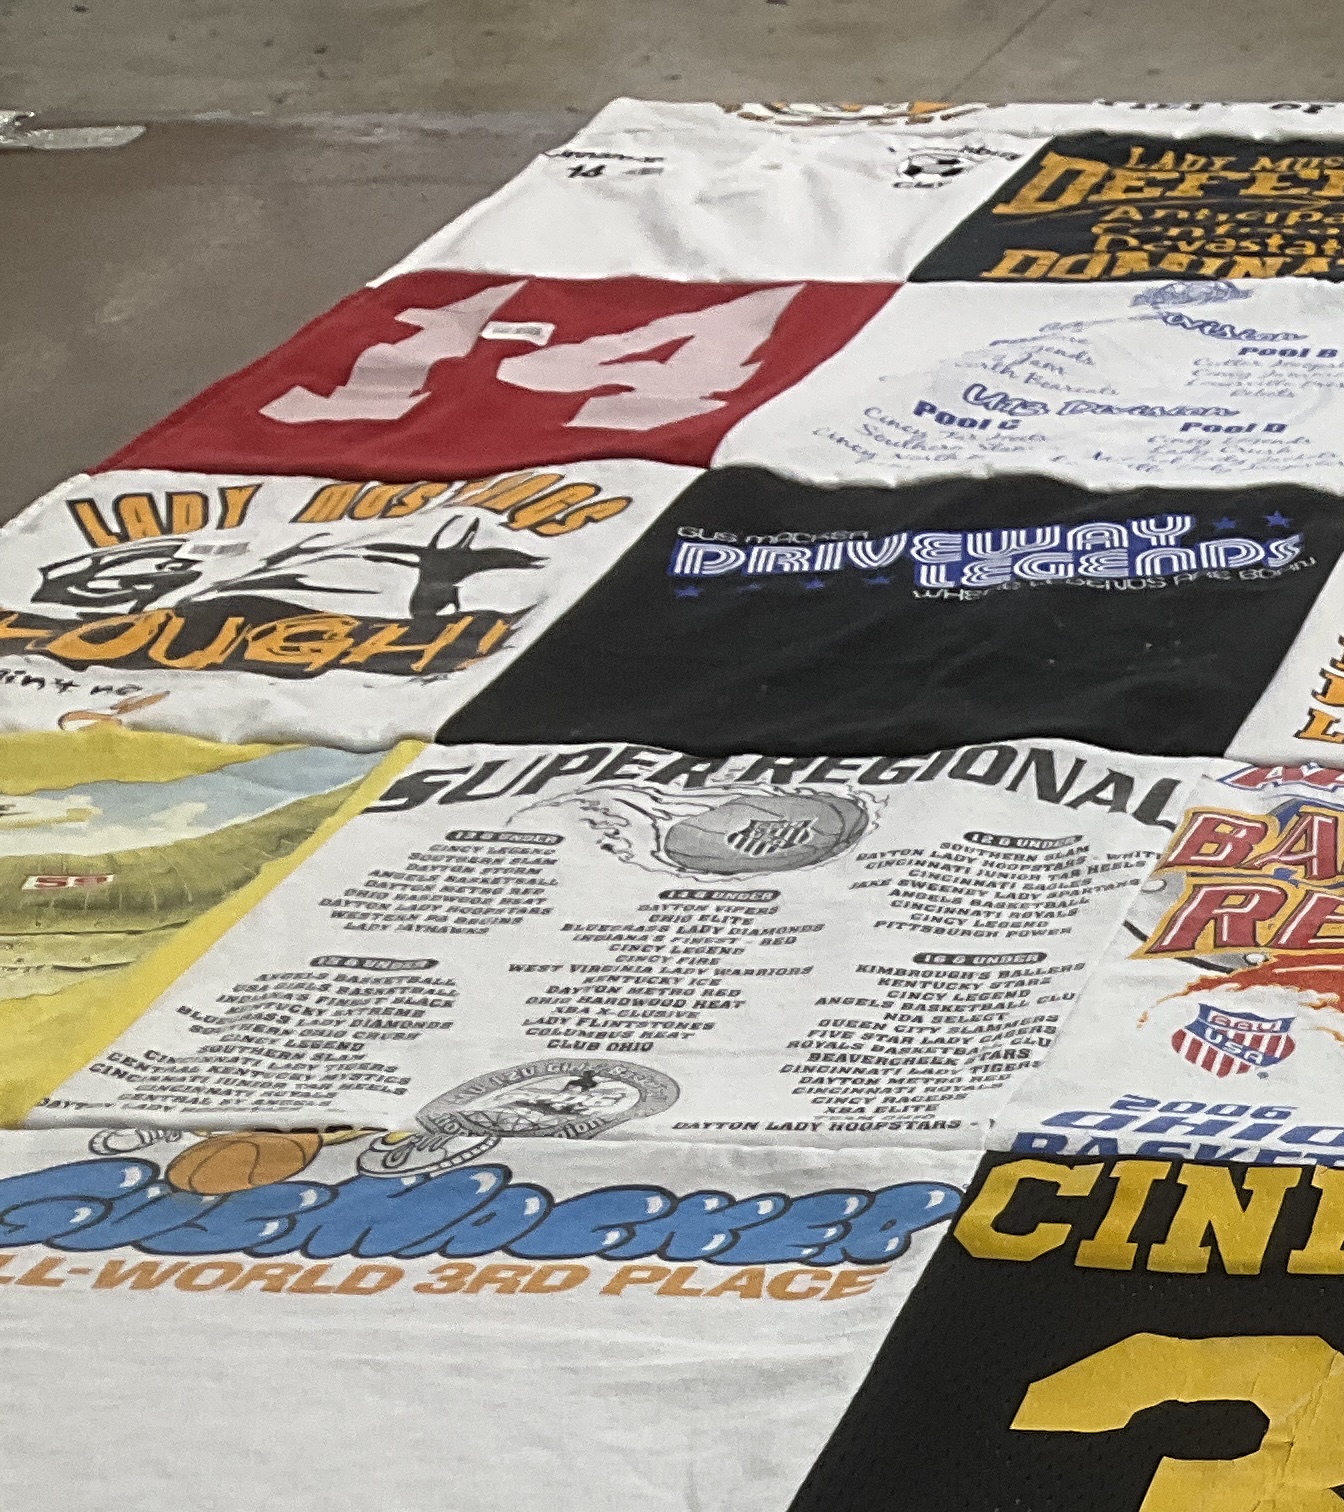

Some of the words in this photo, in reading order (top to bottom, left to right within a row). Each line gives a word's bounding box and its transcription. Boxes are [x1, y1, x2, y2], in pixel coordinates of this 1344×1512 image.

[1125, 147, 1232, 171] LADY
[1238, 346, 1314, 358] Pool
[914, 400, 992, 431] Pool
[1180, 421, 1243, 434] Pool
[66, 483, 263, 547] LADY
[290, 473, 633, 536] MUSTANGS
[668, 514, 1194, 577] DRIVEWAY
[916, 534, 1303, 590] LEGENDS
[373, 746, 714, 813] SUPER
[734, 738, 1194, 831] REGIONAL
[546, 1038, 601, 1051] CLUB
[1201, 1027, 1266, 1067] USA
[1109, 1094, 1299, 1122] 2006
[671, 1119, 760, 1131] DAYTON
[764, 1120, 823, 1132] LADY
[828, 1119, 962, 1132] HOOPSTARS
[413, 1262, 591, 1297] 3RD
[599, 1263, 896, 1301] PLACE
